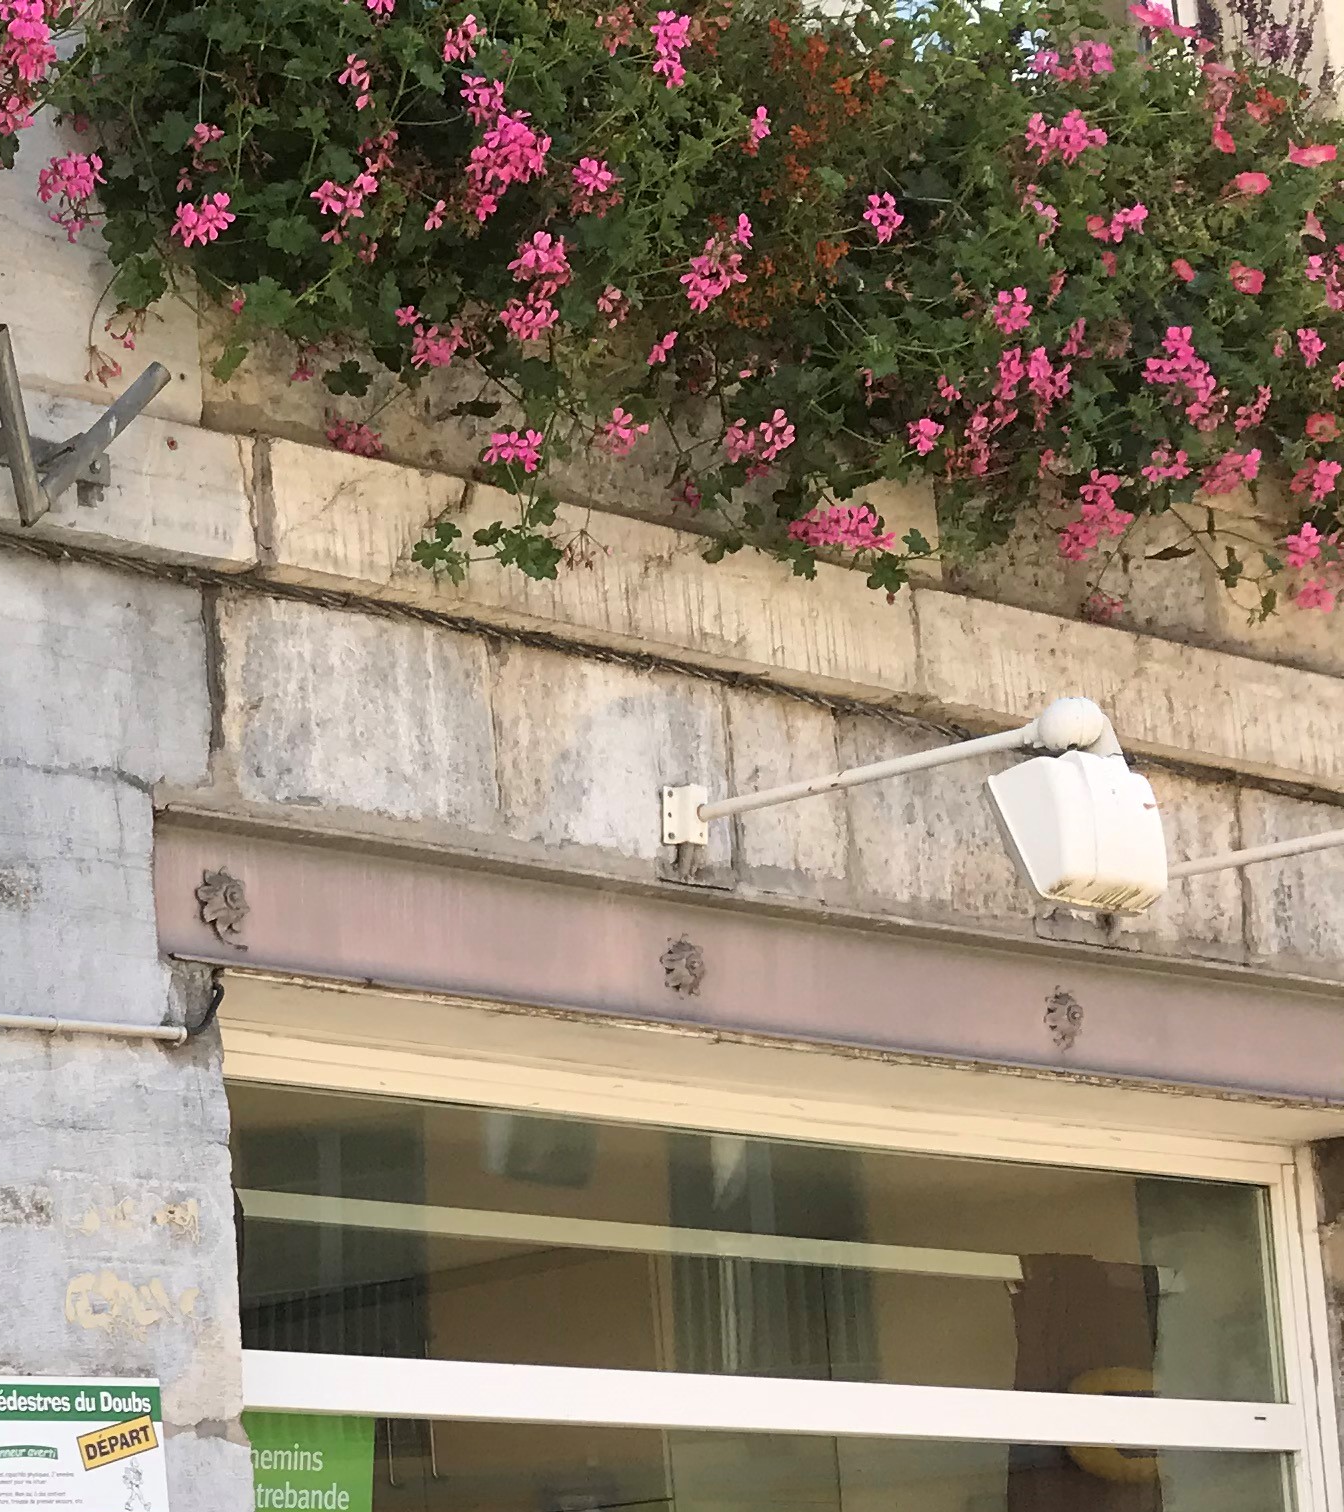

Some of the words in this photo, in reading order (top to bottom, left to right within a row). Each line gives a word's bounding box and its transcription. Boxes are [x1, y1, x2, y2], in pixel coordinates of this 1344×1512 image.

[75, 1391, 96, 1413] du
[100, 1391, 152, 1413] Doubs
[27, 1448, 56, 1459] averti
[84, 1425, 151, 1461] DÉPART
